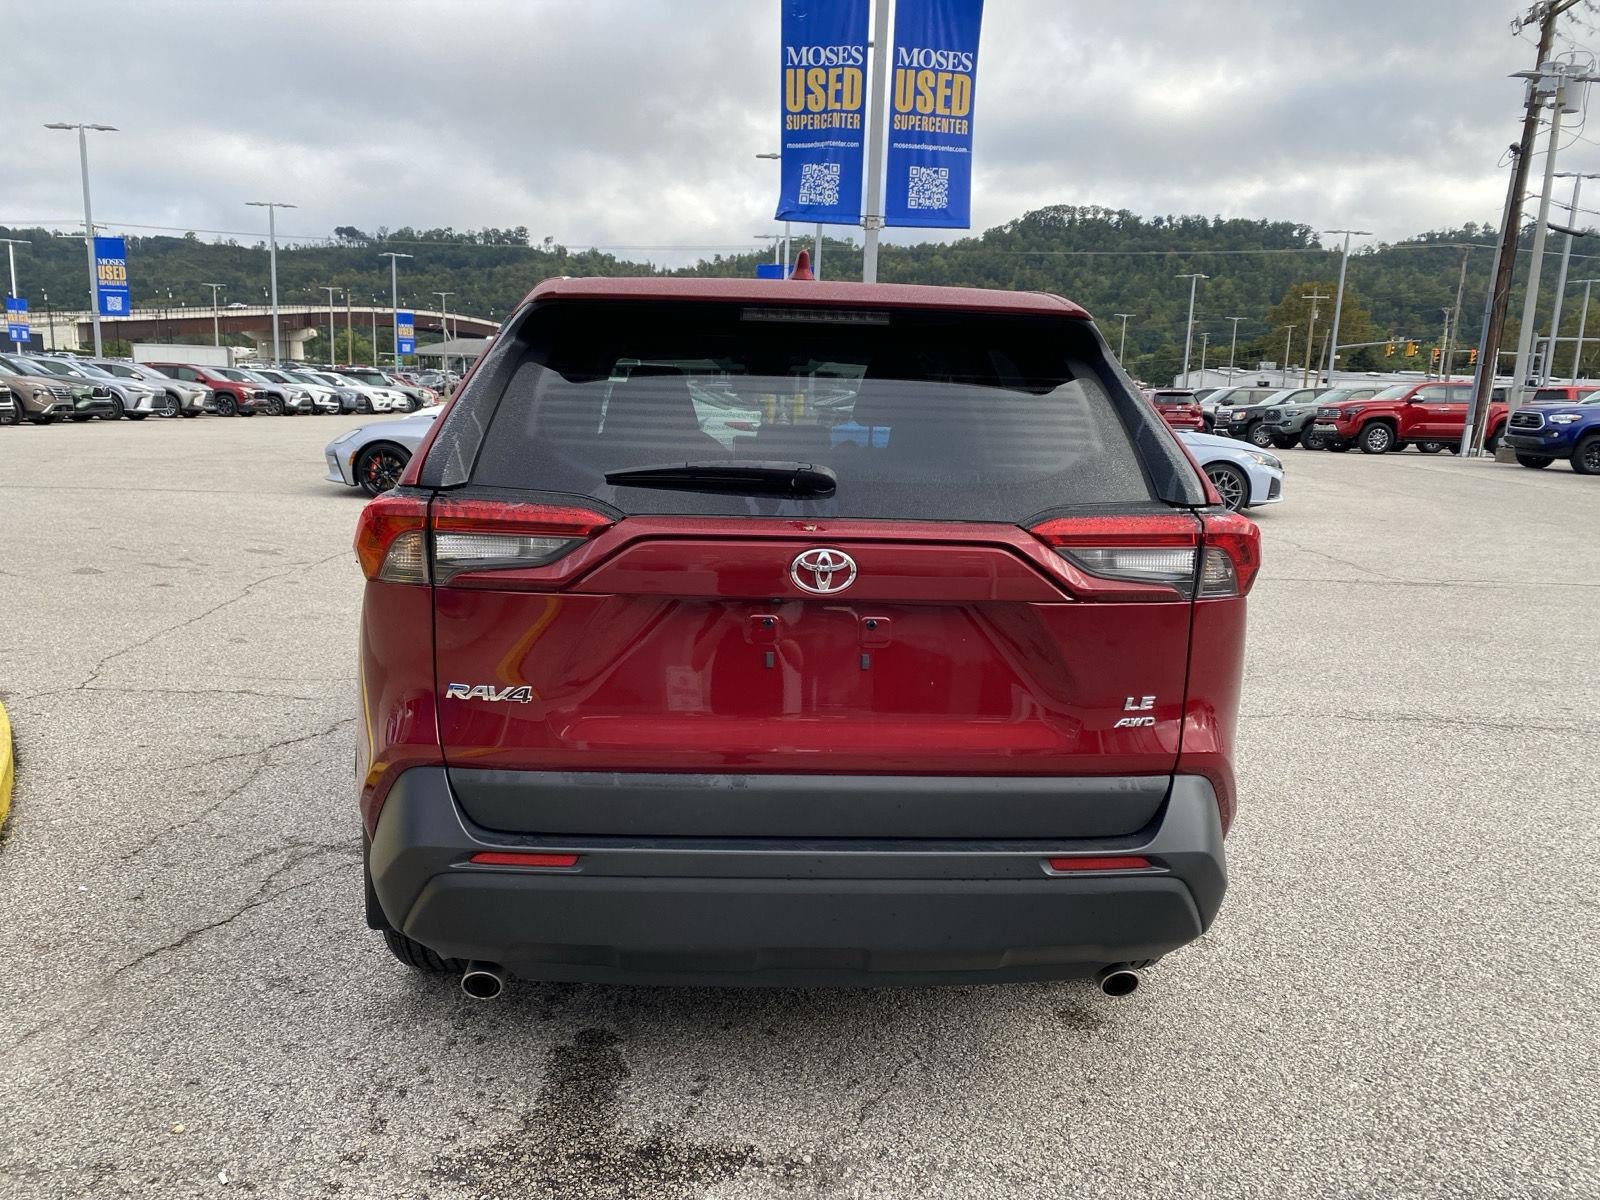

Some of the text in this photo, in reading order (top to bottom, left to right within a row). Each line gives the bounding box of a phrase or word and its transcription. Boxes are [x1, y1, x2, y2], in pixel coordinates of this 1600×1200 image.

[786, 45, 864, 66] MOSES
[897, 47, 973, 72] MOSES
[785, 67, 863, 113] USED
[894, 69, 971, 116] USED
[786, 112, 861, 130] SUPERCENTER
[894, 115, 968, 135] SUPERCENTER
[786, 140, 860, 149] mosesusedsupercenter.com
[893, 142, 968, 153] mosesusedsupercenter.com
[98, 265, 126, 280] USED
[445, 683, 533, 704] RAV4
[1124, 696, 1156, 710] LE
[1113, 716, 1156, 729] AWD
